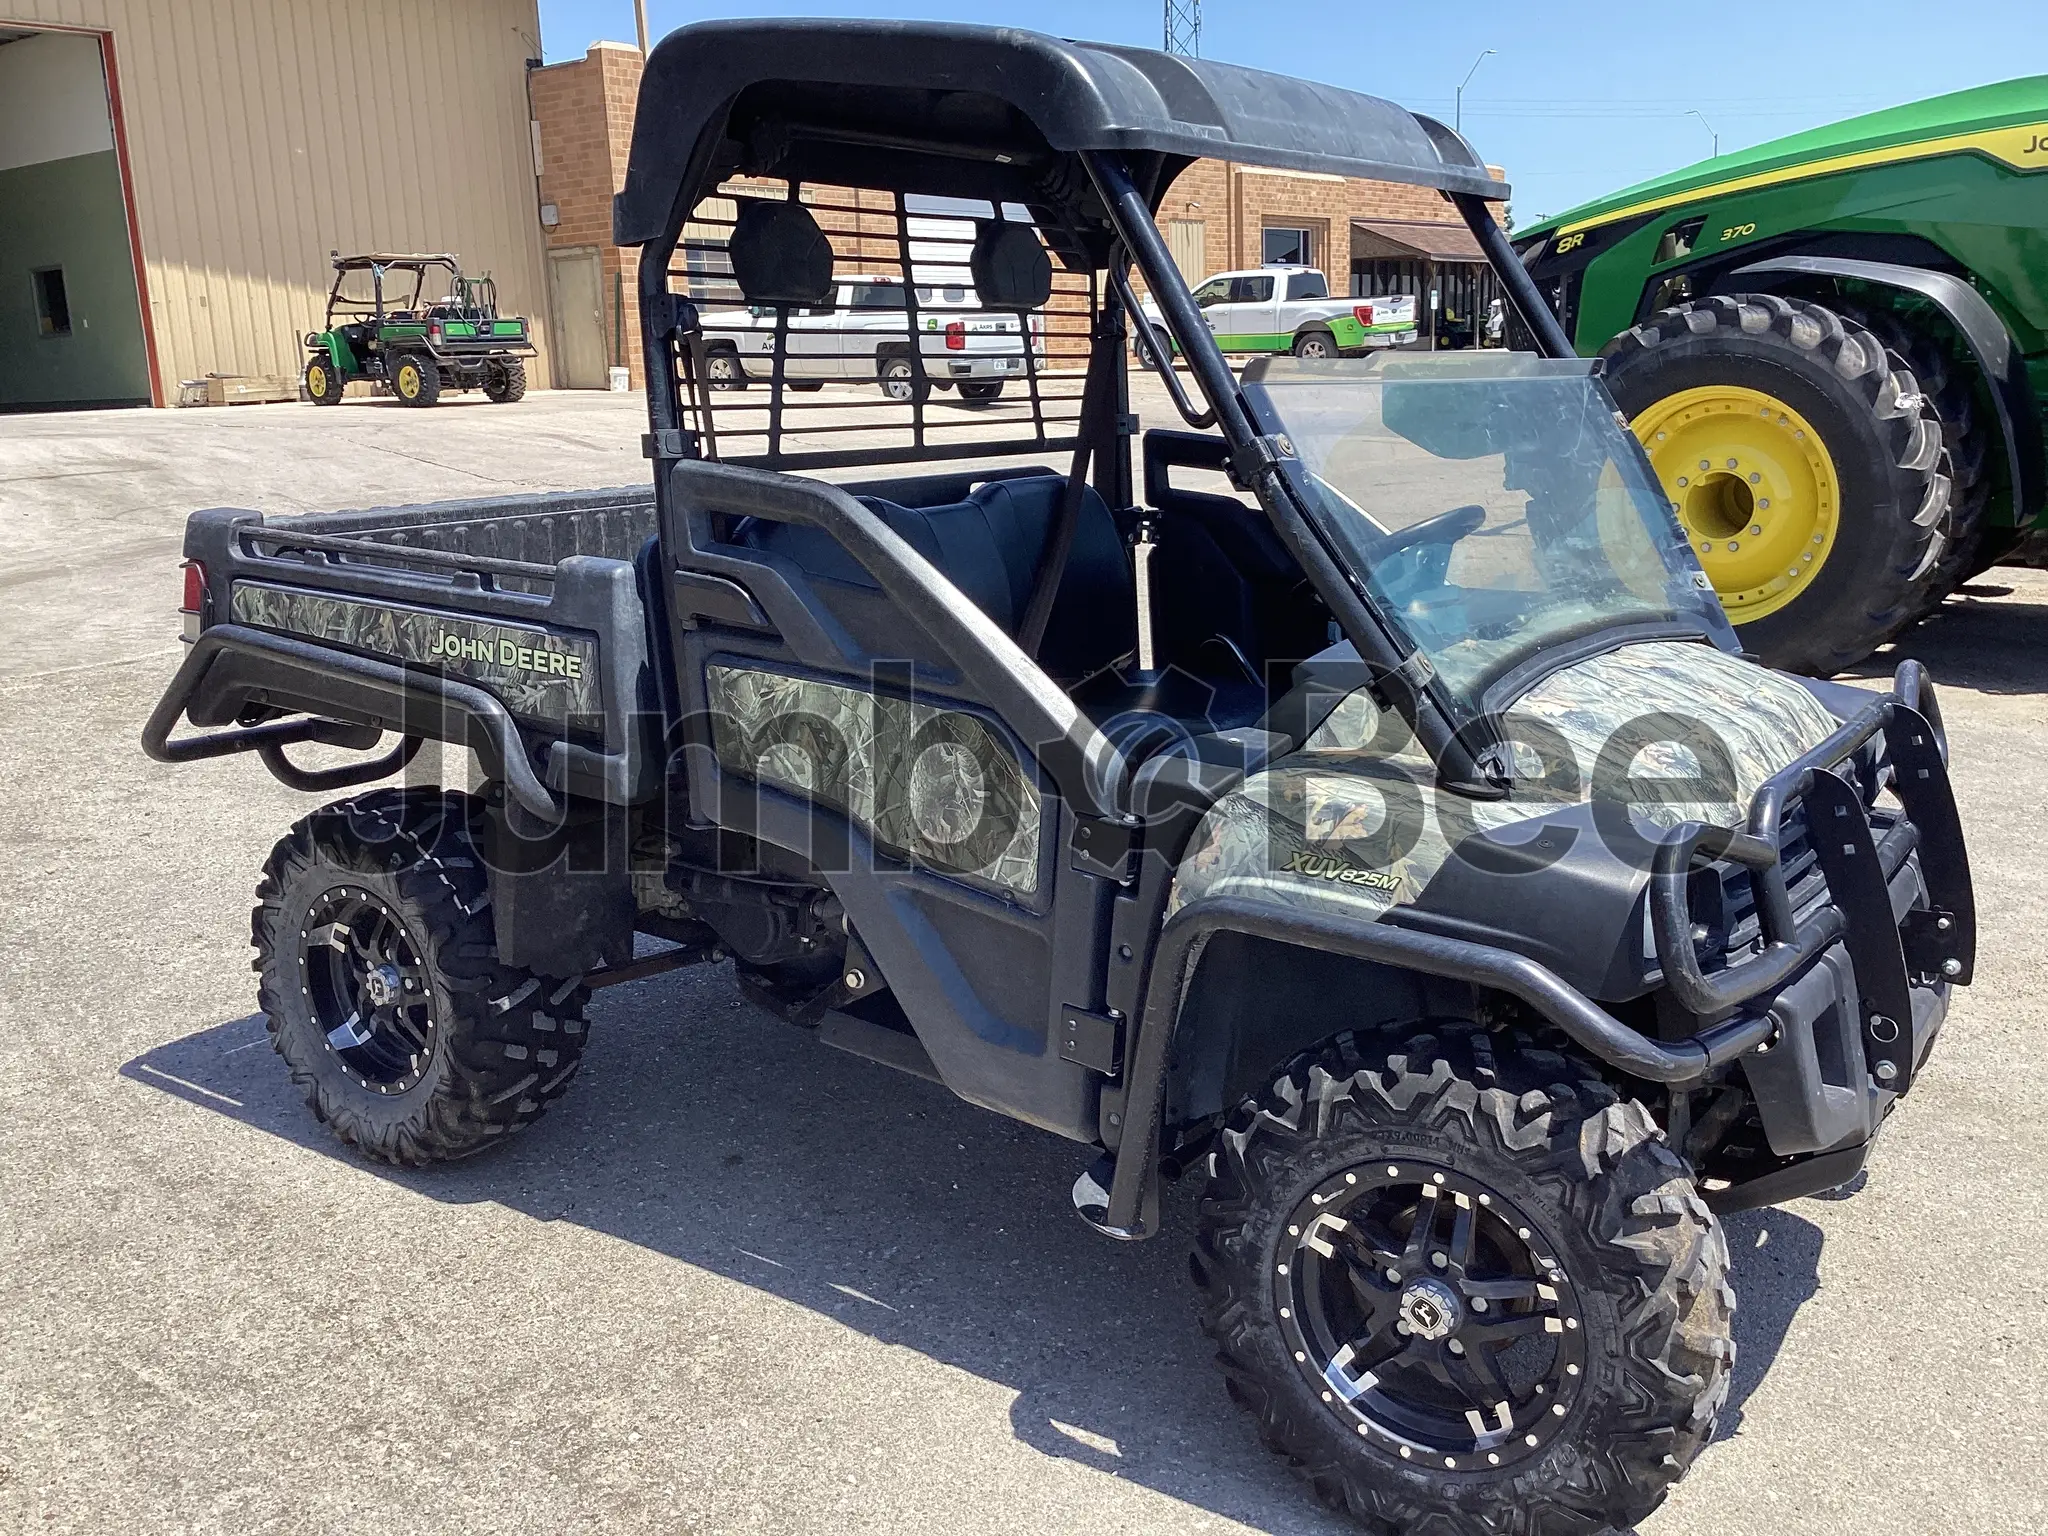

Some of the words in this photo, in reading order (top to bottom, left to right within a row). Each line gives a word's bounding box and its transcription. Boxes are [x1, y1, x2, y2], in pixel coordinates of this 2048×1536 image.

[1720, 223, 1756, 241] 370
[1556, 233, 1585, 254] 8R
[499, 639, 582, 679] DEERE
